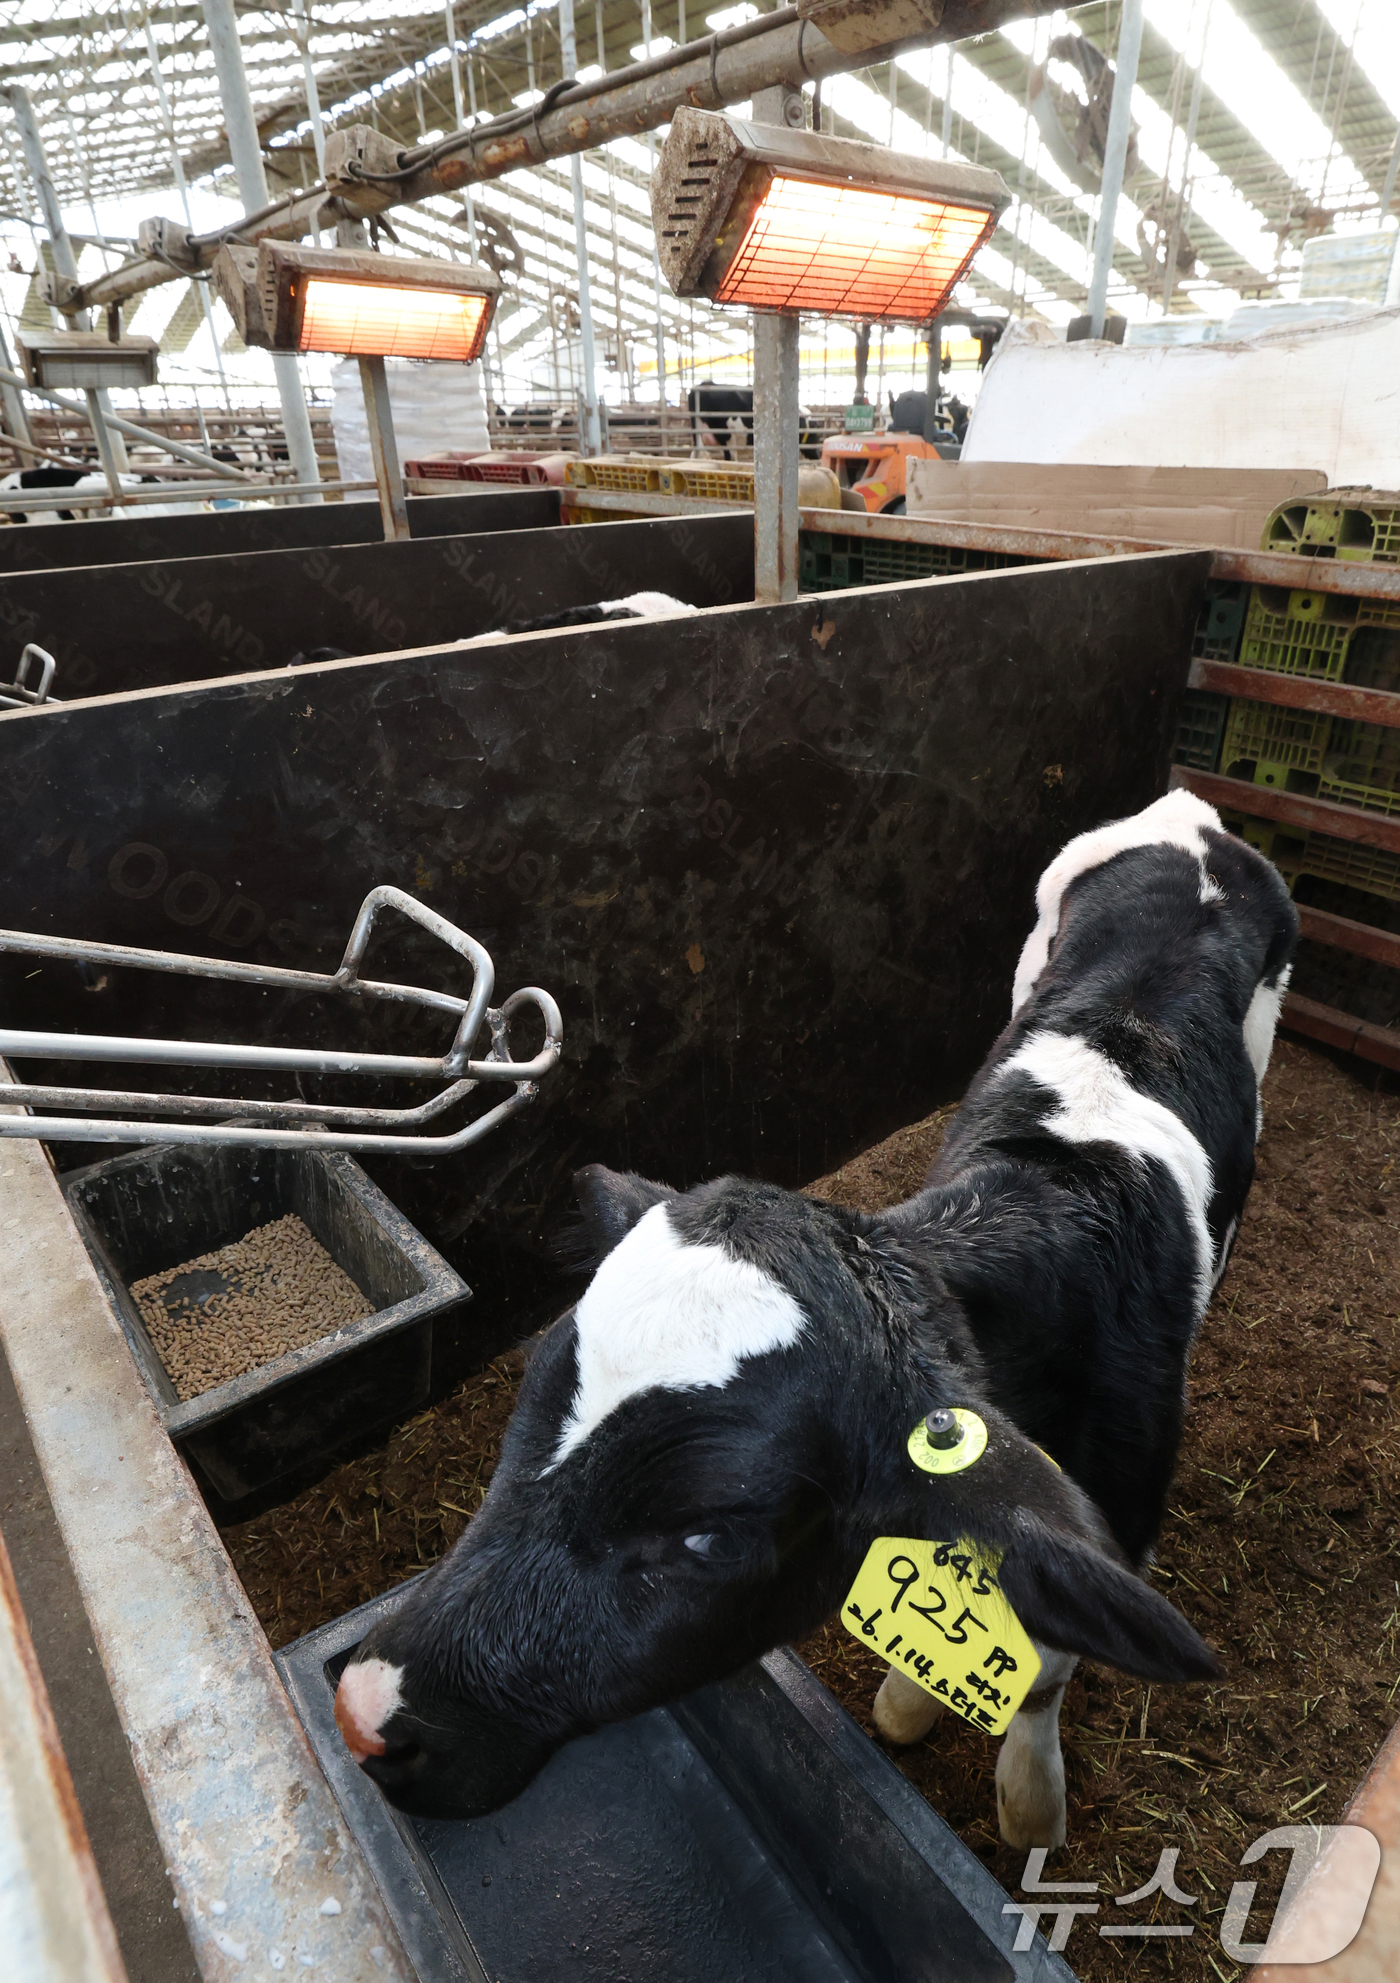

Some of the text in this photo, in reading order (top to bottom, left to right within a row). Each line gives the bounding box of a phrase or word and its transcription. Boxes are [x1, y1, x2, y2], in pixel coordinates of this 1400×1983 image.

[933, 1541, 1000, 1595] 645
[887, 1555, 989, 1645] 925
[983, 1645, 1018, 1678] PP
